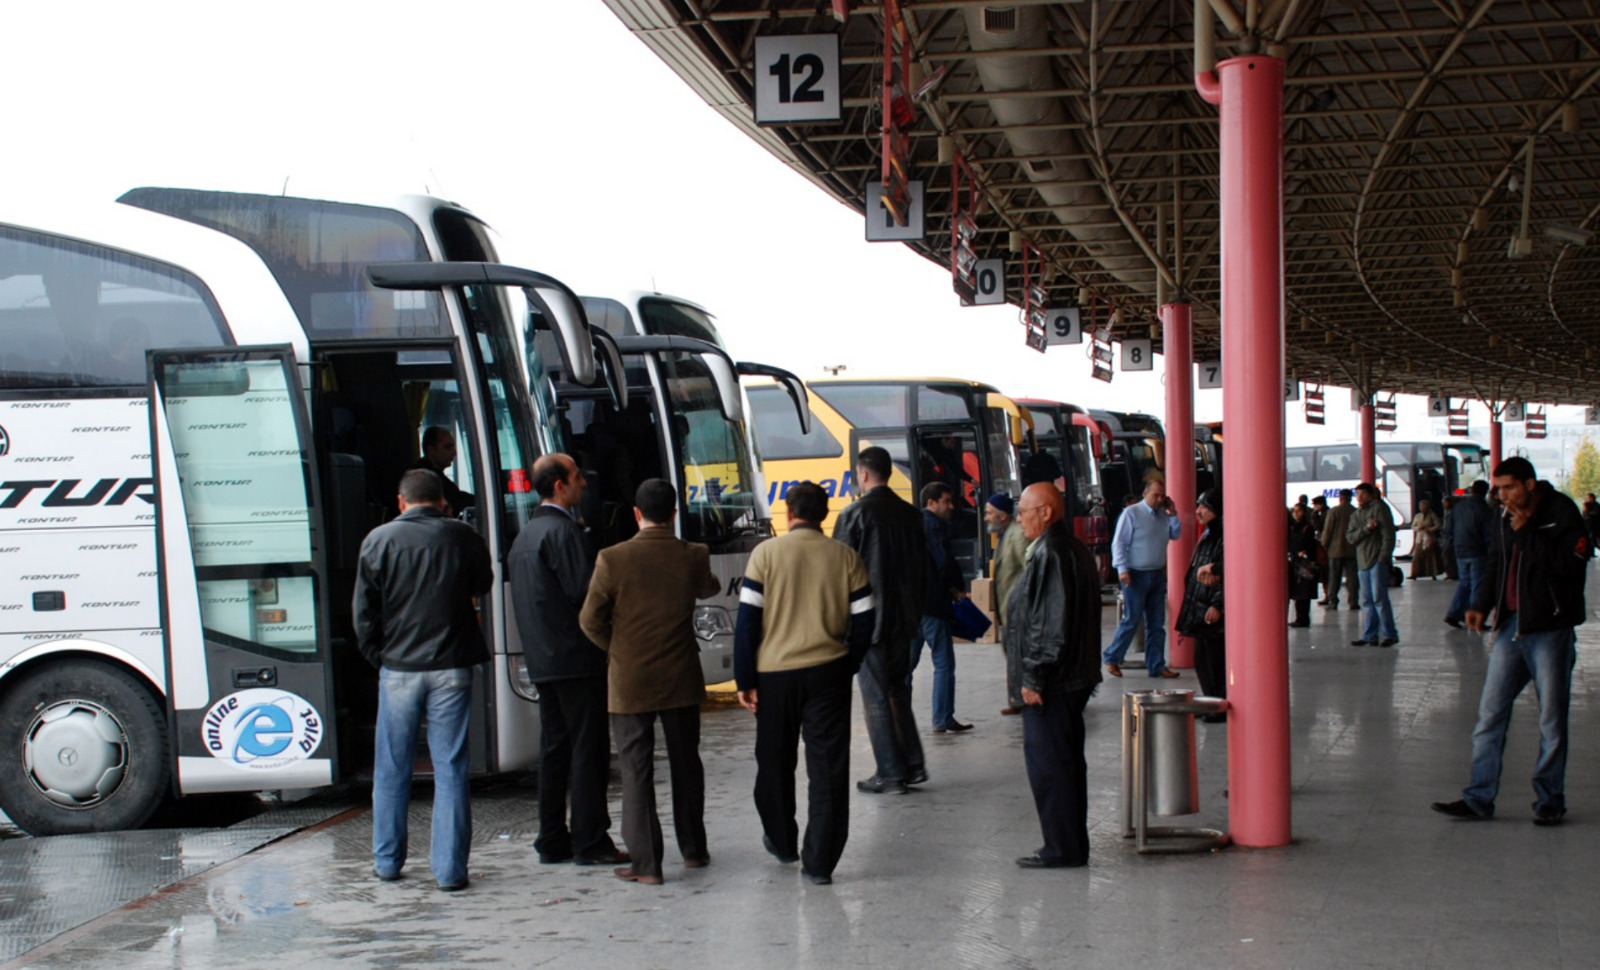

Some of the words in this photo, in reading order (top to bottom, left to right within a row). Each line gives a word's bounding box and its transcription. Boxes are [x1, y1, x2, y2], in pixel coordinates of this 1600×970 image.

[769, 53, 824, 103] 12
[1054, 316, 1071, 337] 9
[1131, 347, 1142, 364] 8
[1206, 367, 1217, 383] 7
[1433, 400, 1442, 412] 4
[1510, 406, 1518, 417] 3
[1590, 411, 1598, 421] 2
[206, 697, 238, 751] online
[299, 708, 319, 753] bilet
